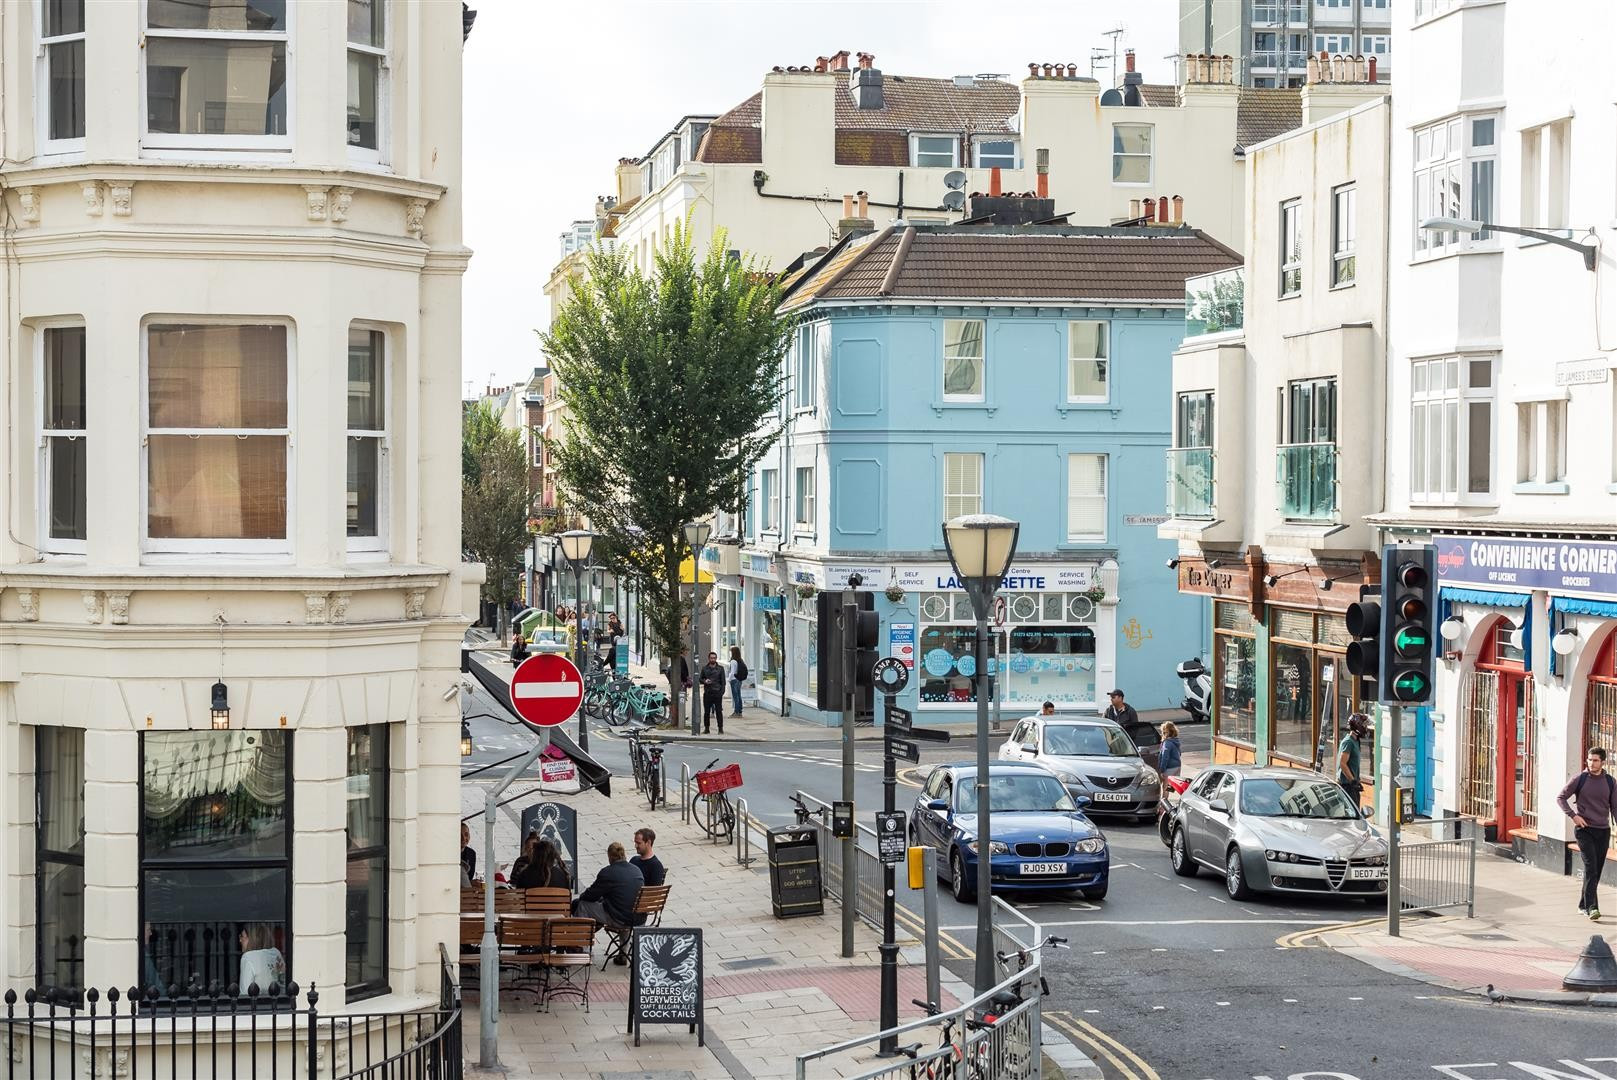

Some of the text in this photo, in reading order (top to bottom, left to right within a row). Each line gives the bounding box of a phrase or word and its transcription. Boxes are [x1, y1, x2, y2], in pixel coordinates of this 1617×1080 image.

[1470, 541, 1617, 574] CONVENIENCE CORNER
[1488, 571, 1517, 583] OFF LICENCE
[1562, 576, 1591, 587] GROCERIES
[874, 660, 891, 681] KEMP
[893, 660, 906, 681] TOWN
[1023, 863, 1064, 873] RJ09 XSX
[1354, 869, 1374, 878] DE07
[642, 1010, 696, 1018] COCKTAILS
